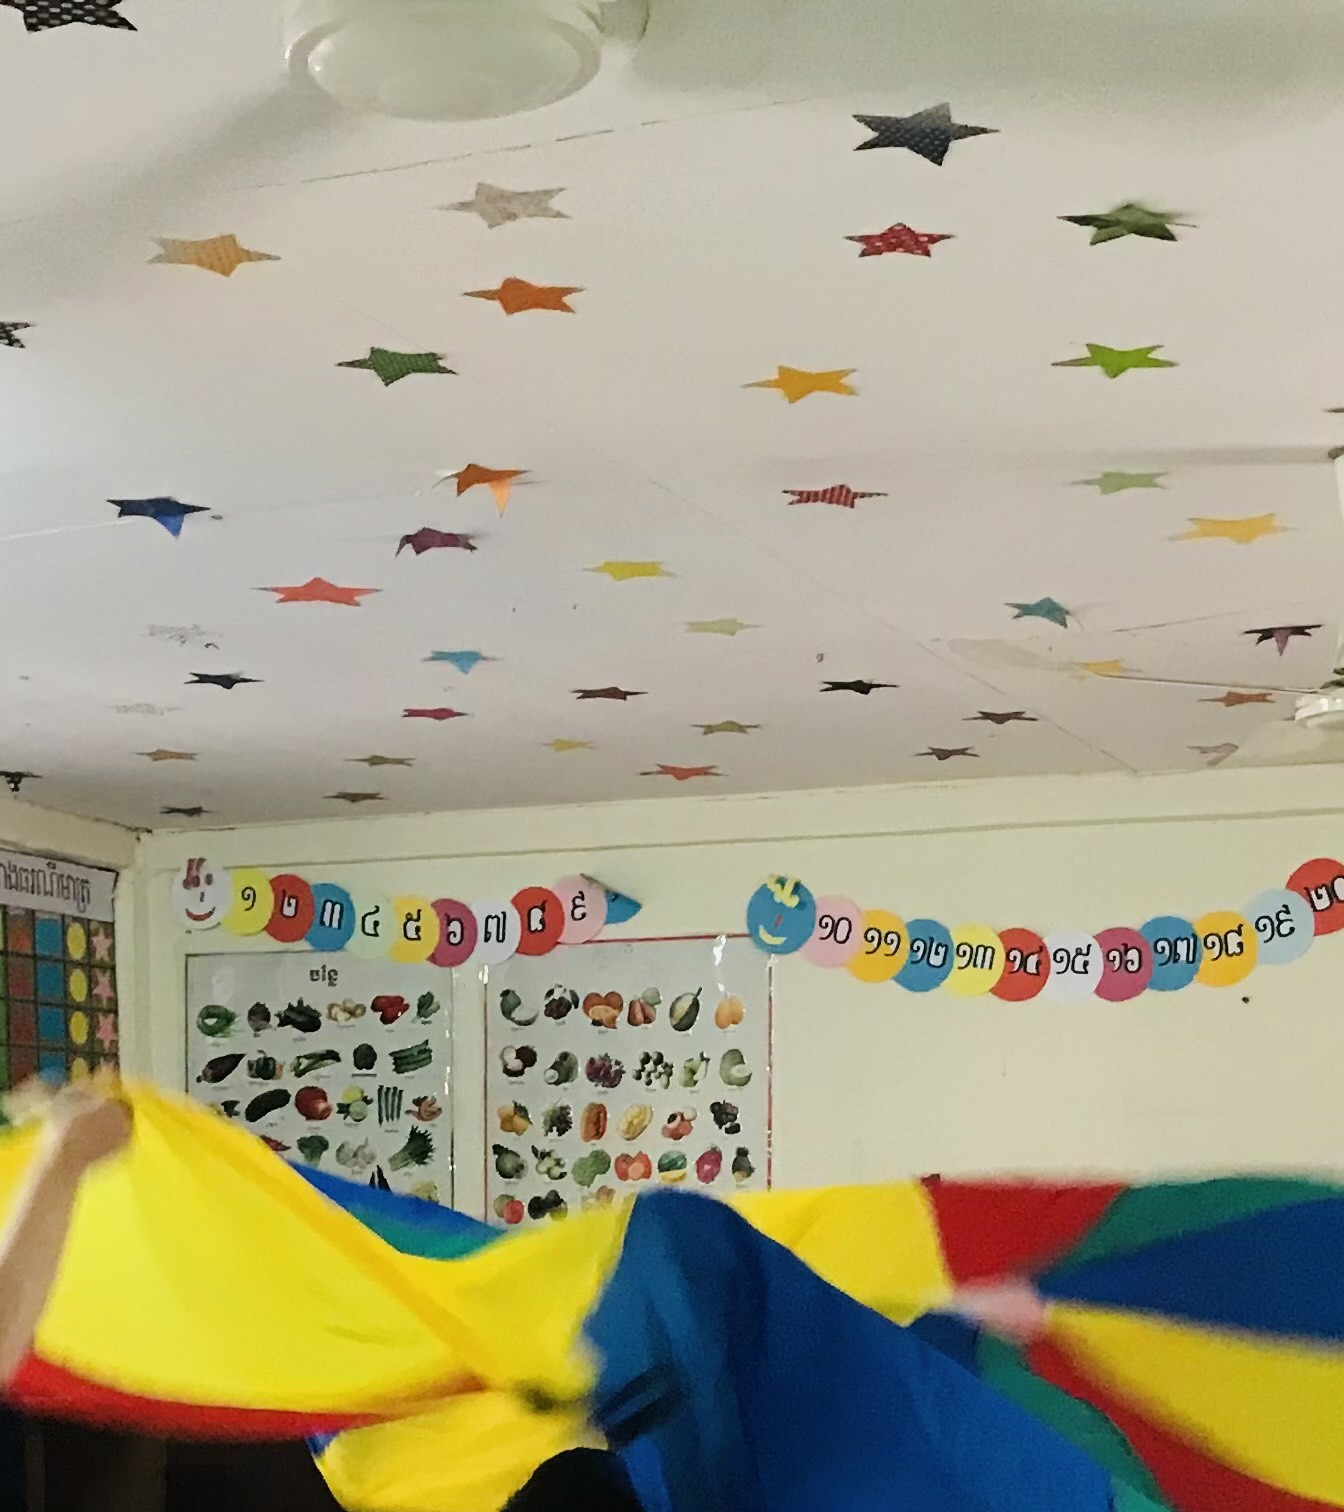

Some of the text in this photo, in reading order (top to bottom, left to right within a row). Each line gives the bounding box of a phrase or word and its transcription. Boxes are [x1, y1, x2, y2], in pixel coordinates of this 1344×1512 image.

[241, 886, 587, 946] ១ ២ ៣ ៤ ៥ ៦ ៧ ៨ ៩
[818, 914, 853, 944] ១០
[864, 927, 901, 956] ១១
[910, 936, 948, 968] ១២
[956, 942, 996, 970] ១៣
[1008, 945, 1044, 976] ១៤
[1052, 943, 1092, 975] ១៥
[1107, 943, 1142, 973] ១៦
[1154, 933, 1197, 967] ១៧
[1203, 924, 1244, 961] ១៨
[1254, 904, 1295, 943] ១៩
